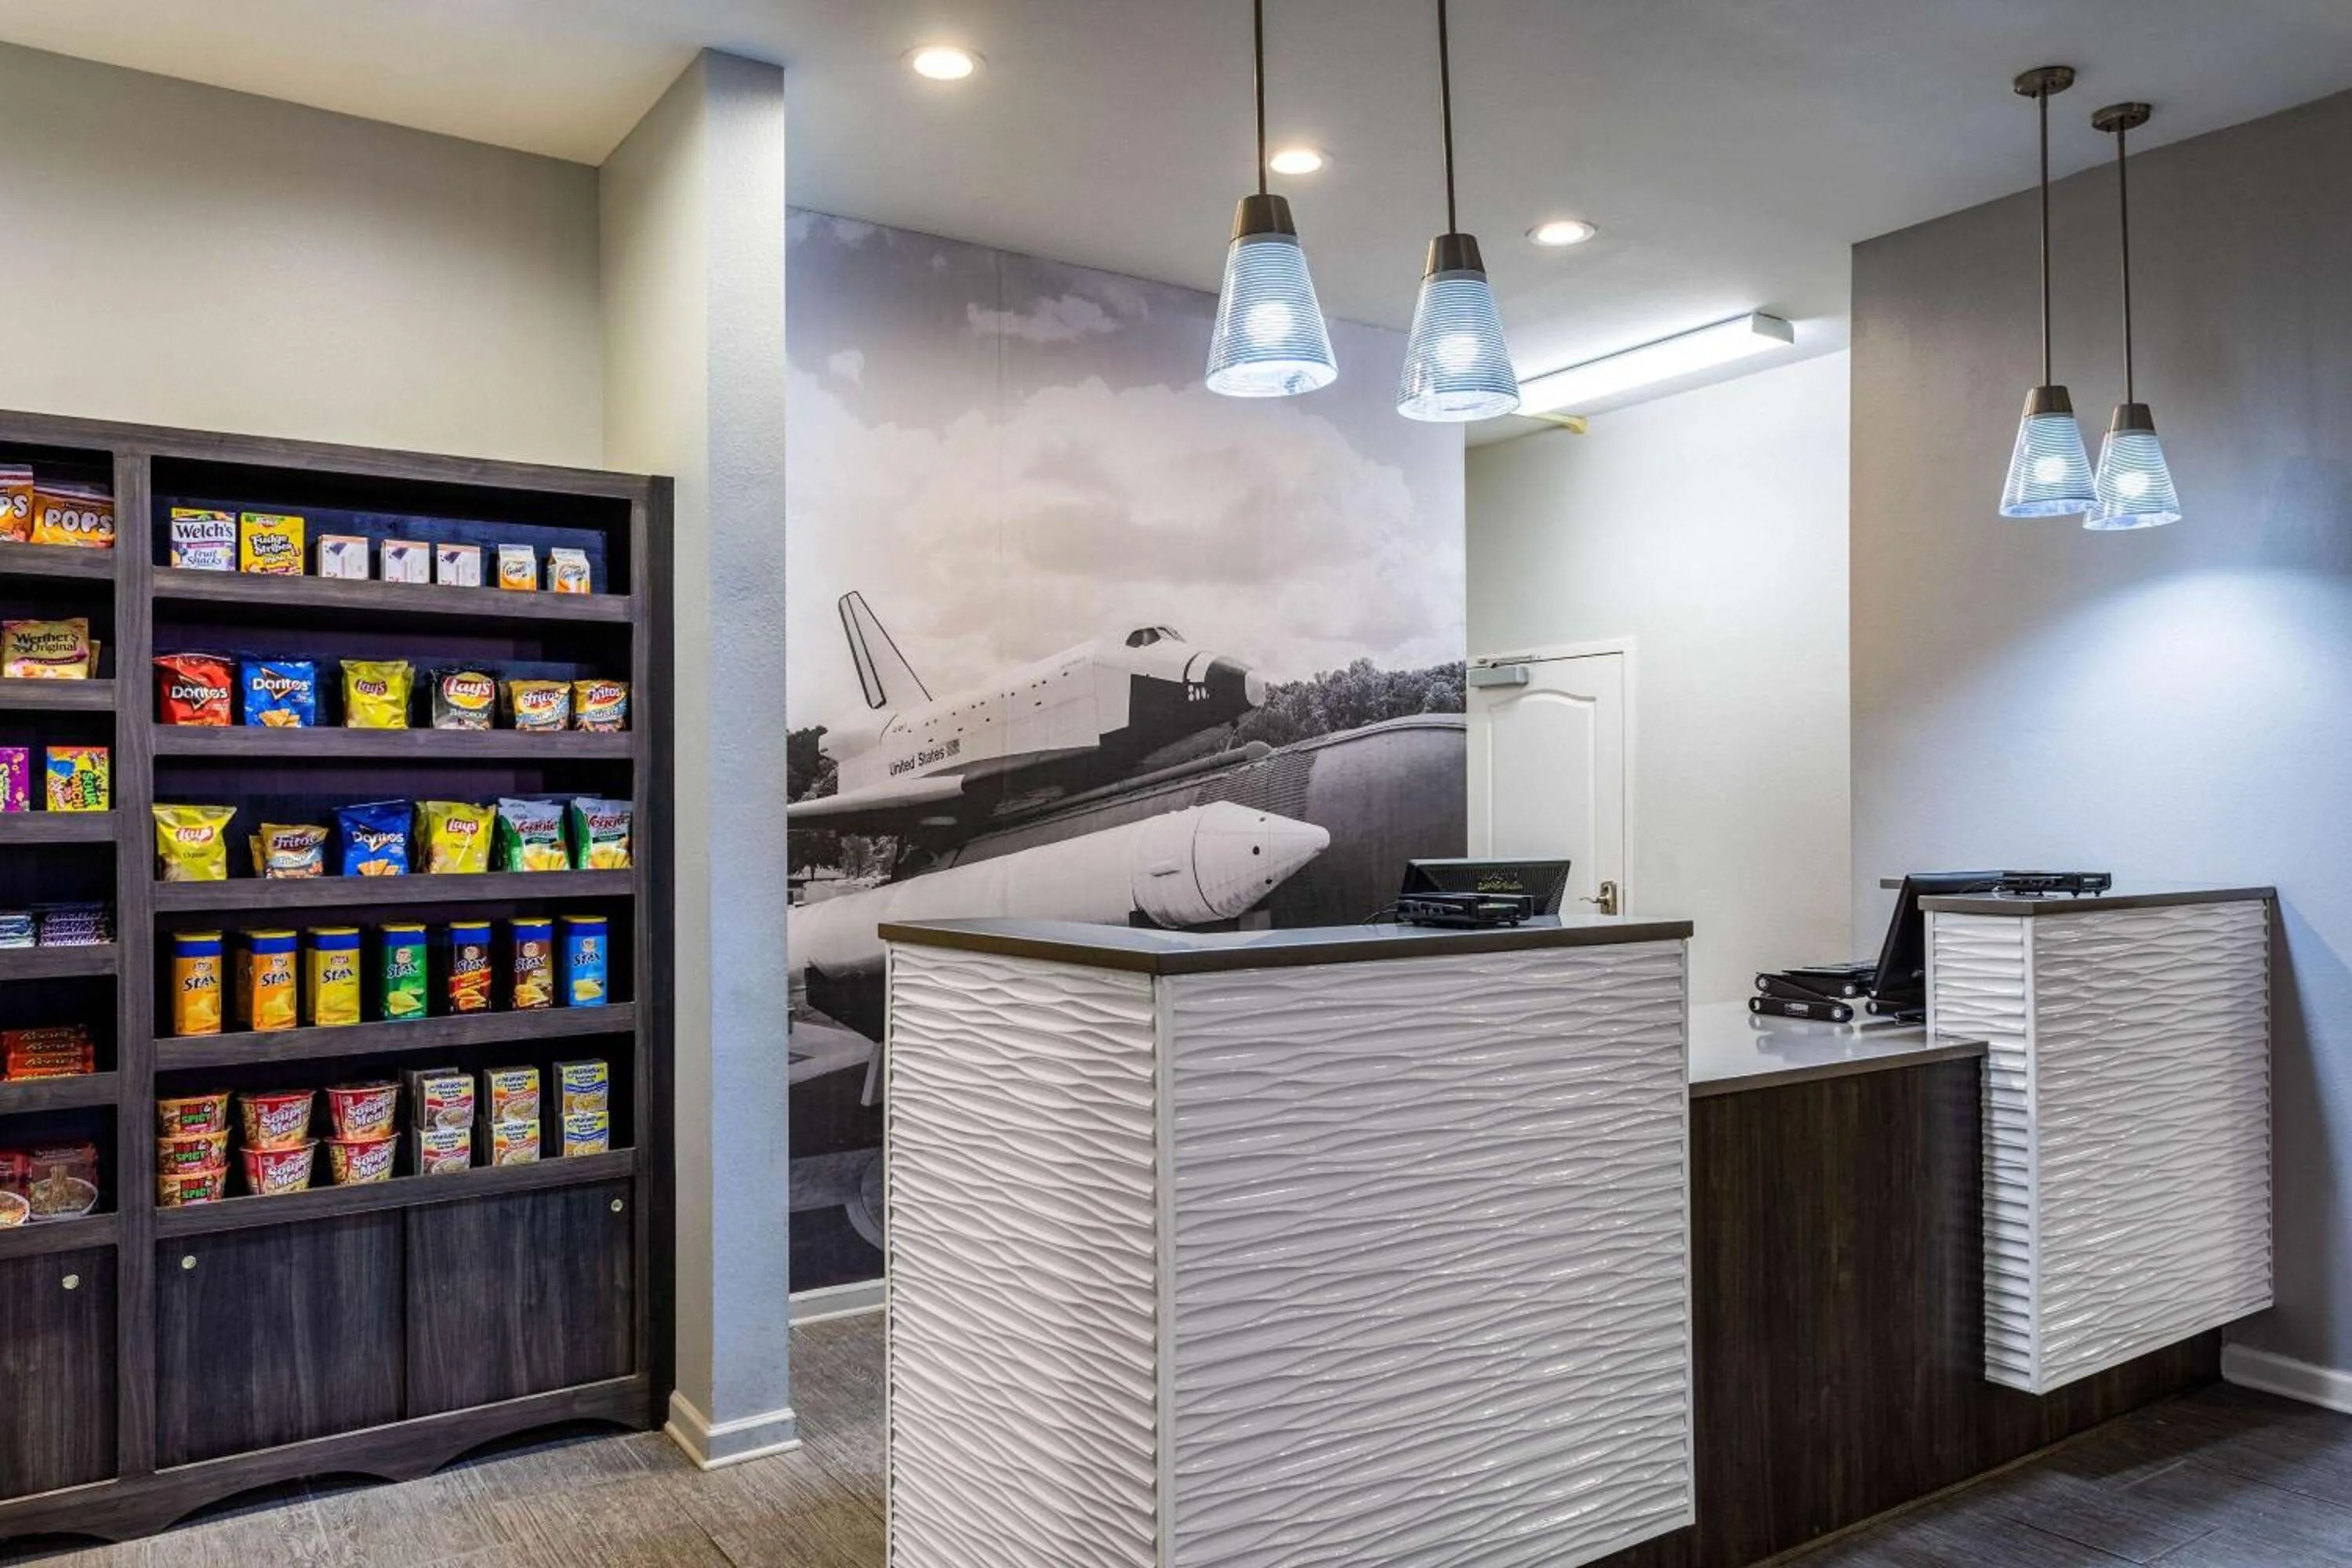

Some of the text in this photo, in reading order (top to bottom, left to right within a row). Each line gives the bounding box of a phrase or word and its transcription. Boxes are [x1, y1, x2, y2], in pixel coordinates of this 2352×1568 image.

[45, 508, 114, 533] POPS
[175, 523, 234, 539] Welch's
[250, 534, 289, 546] Fudge
[194, 549, 217, 557] Fruit
[187, 556, 222, 565] Snacks
[14, 631, 78, 643] Werther's
[30, 641, 77, 653] Original
[252, 677, 310, 691] Doritos
[356, 678, 387, 695] Lay's
[449, 678, 491, 698] Lay's
[172, 685, 227, 699] Doritos
[523, 689, 560, 704] Fritos
[588, 687, 620, 702] Fritos
[889, 747, 945, 776] United States
[82, 771, 98, 804] SOUR
[448, 818, 477, 833] Lay's
[274, 836, 315, 849] Fritos
[352, 831, 405, 844] Doritos
[180, 1103, 204, 1114] HOT
[181, 1112, 209, 1123] SPICY
[354, 1109, 385, 1127] Meal
[270, 1117, 302, 1136] Meal
[174, 1142, 198, 1154] HOT
[175, 1150, 207, 1162] SPICY
[181, 1178, 205, 1189] HOT
[274, 1170, 307, 1188] Meal
